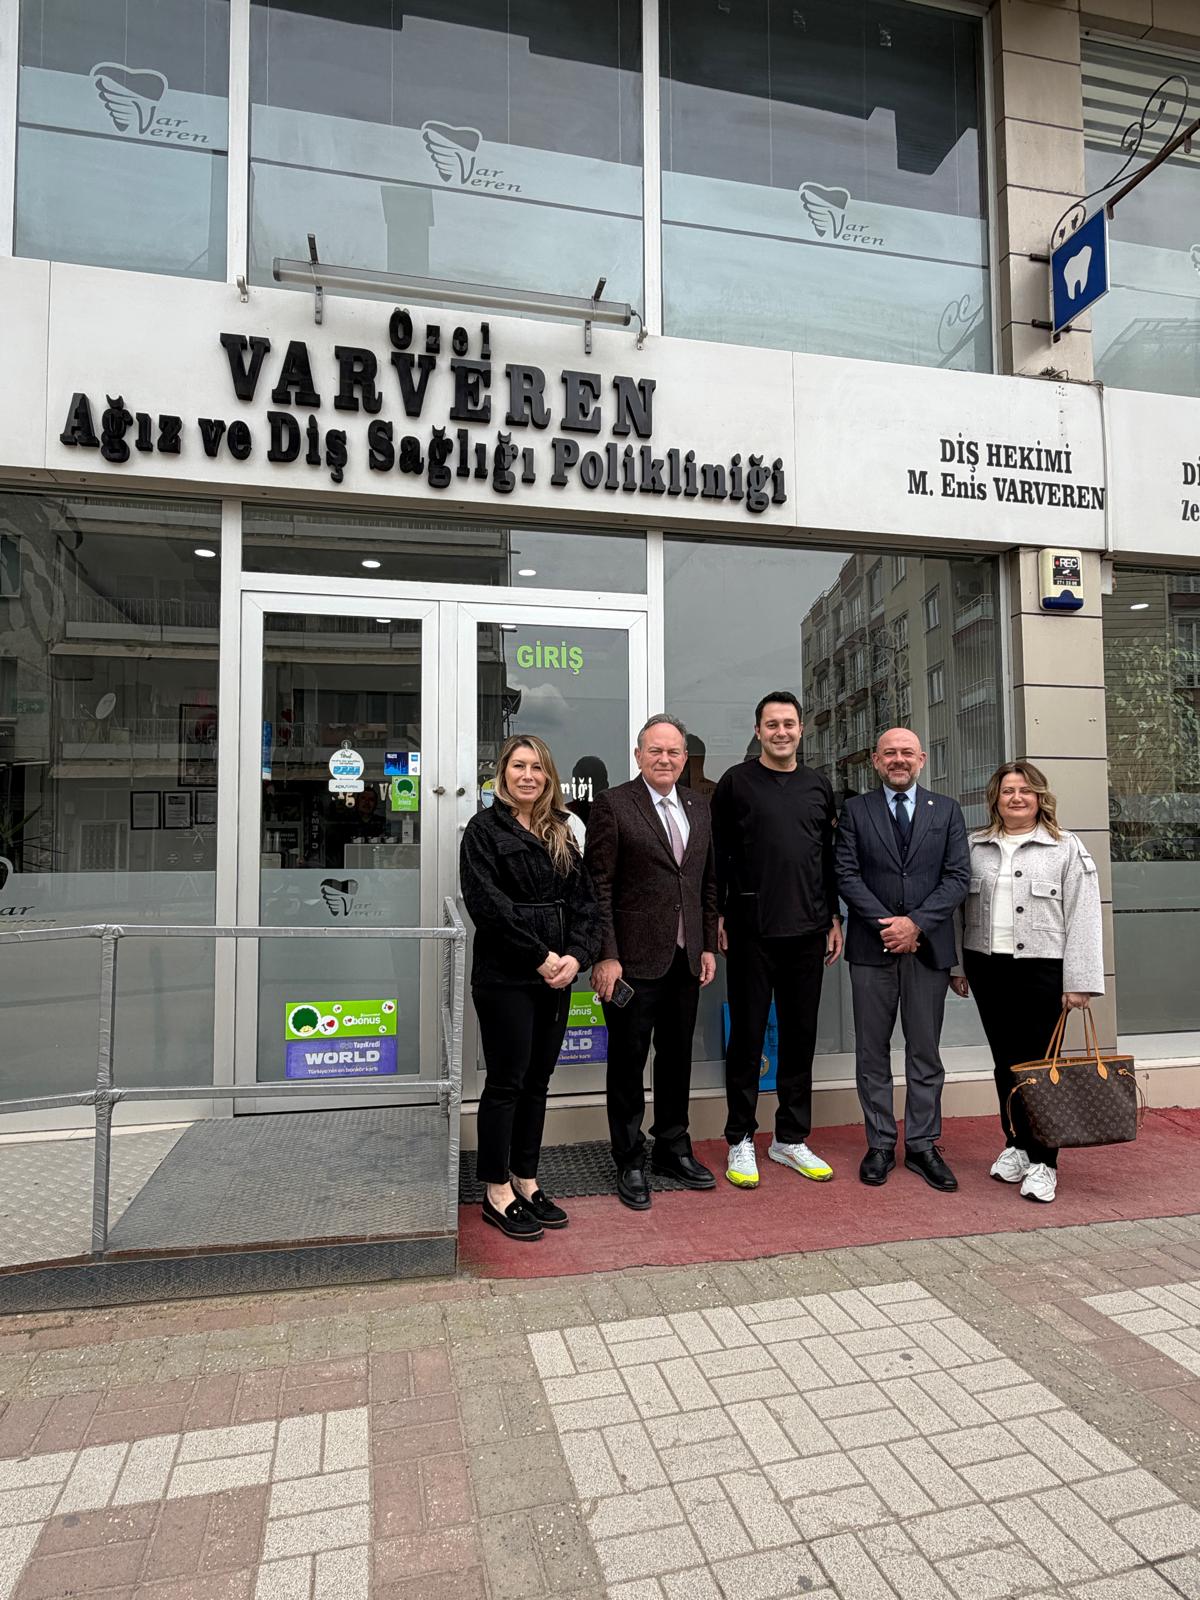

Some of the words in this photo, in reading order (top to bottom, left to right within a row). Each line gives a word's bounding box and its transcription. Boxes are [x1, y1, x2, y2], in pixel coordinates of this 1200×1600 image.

[388, 306, 491, 360] Özel
[219, 332, 657, 438] VARVEREN
[59, 392, 183, 463] Ağız
[198, 417, 252, 460] ve
[266, 410, 348, 483] Diş
[367, 418, 536, 493] Sağlığı
[550, 437, 787, 513] Polikliniği
[940, 432, 980, 473] DİŞ
[986, 440, 1072, 474] HEKİMİ
[907, 469, 934, 496] M.
[941, 473, 987, 500] Enis
[992, 477, 1105, 511] VARVEREN
[517, 640, 584, 675] GİRİŞ
[0, 905, 35, 915] ar
[305, 1050, 380, 1065] WORLD
